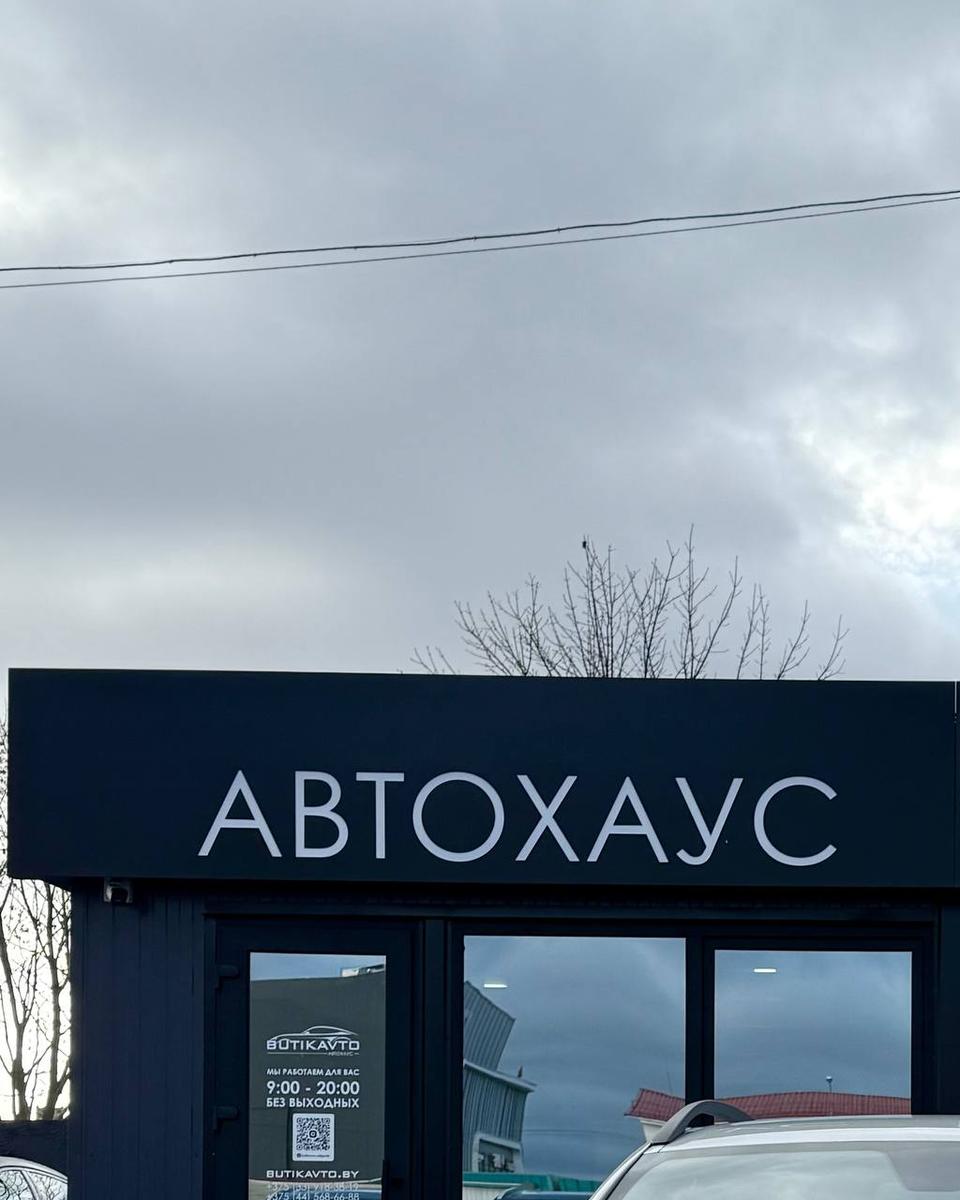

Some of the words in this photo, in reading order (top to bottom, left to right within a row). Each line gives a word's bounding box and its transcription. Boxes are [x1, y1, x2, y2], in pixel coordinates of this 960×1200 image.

[198, 769, 838, 866] АВТОХАУС
[266, 1039, 360, 1050] BUTIKAVTO
[266, 1068, 281, 1076] МЫ
[282, 1068, 324, 1076] РАБОТАЕМ
[325, 1068, 342, 1077] ДЛЯ
[343, 1068, 360, 1076] ВАС
[266, 1081, 300, 1095] 9:00
[316, 1081, 360, 1095] 20:00
[266, 1097, 286, 1108] БЕЗ
[289, 1097, 360, 1109] ВЫХОДНЫХ
[266, 1169, 359, 1179] BUTIKAVTO.BY
